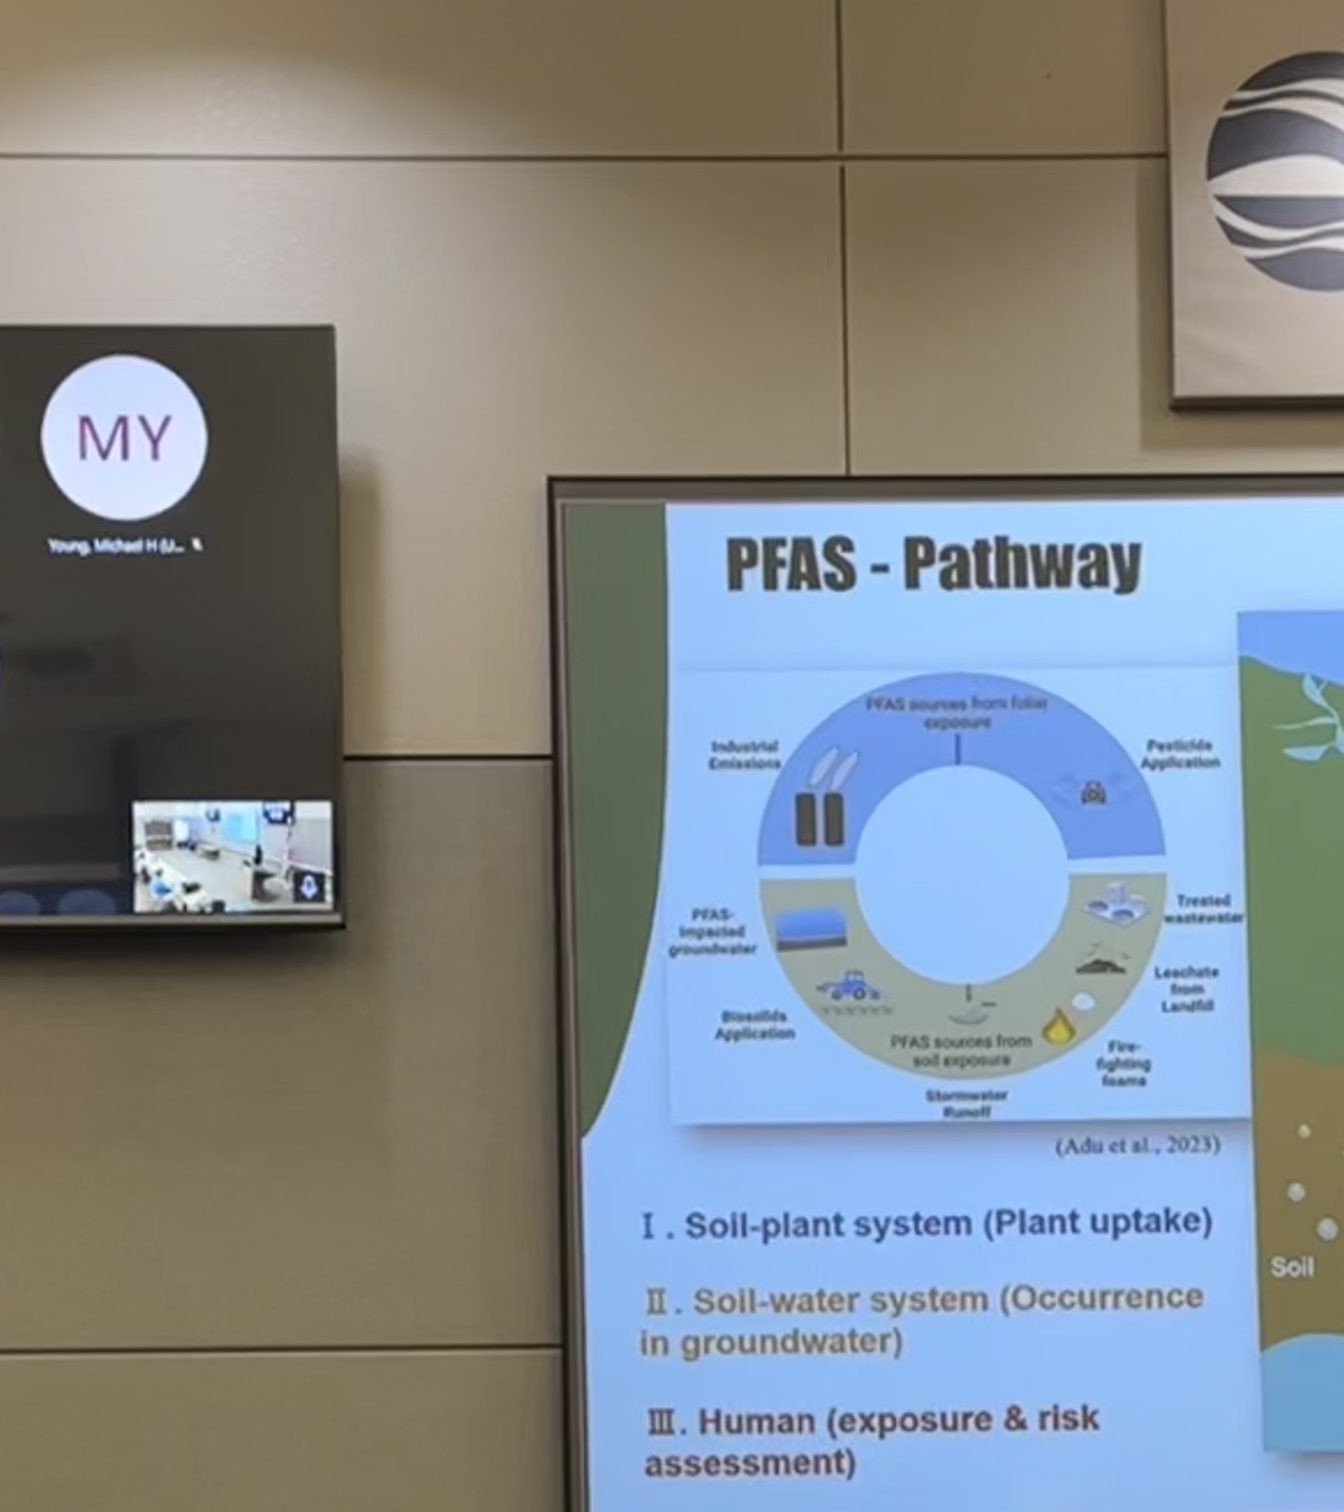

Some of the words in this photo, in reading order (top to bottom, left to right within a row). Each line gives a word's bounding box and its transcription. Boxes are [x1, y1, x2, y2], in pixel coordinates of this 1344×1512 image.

[77, 413, 172, 462] MY
[93, 537, 143, 555] Michael
[726, 535, 856, 591] PFAS
[904, 535, 1142, 595] Pathway
[1176, 894, 1232, 908] Treated
[1164, 911, 1244, 924] wastewater
[1154, 965, 1220, 980] Leachate
[890, 1034, 930, 1048] PFAS
[934, 1035, 993, 1049] sources
[996, 1033, 1034, 1048] from
[912, 1053, 940, 1067] soil
[943, 1054, 1012, 1069] exposure
[1055, 1136, 1104, 1158] (Adu
[1108, 1138, 1127, 1155] et
[1167, 1135, 1222, 1156] 2023)
[685, 1210, 845, 1245] Soil-plant
[854, 1211, 972, 1244] system
[984, 1207, 1081, 1242] (Plant
[1090, 1206, 1213, 1241] uptake)
[1271, 1256, 1315, 1279] Soil
[693, 1286, 861, 1315] Soil-water
[870, 1285, 989, 1319] system
[999, 1283, 1205, 1317] (Occurrence
[640, 1329, 669, 1356] in
[681, 1326, 903, 1362] groundwater)
[699, 1407, 816, 1436] Human
[826, 1406, 994, 1439] (exposure
[1004, 1404, 1029, 1432] &
[1039, 1403, 1101, 1432] risk
[644, 1447, 857, 1479] assessment)
